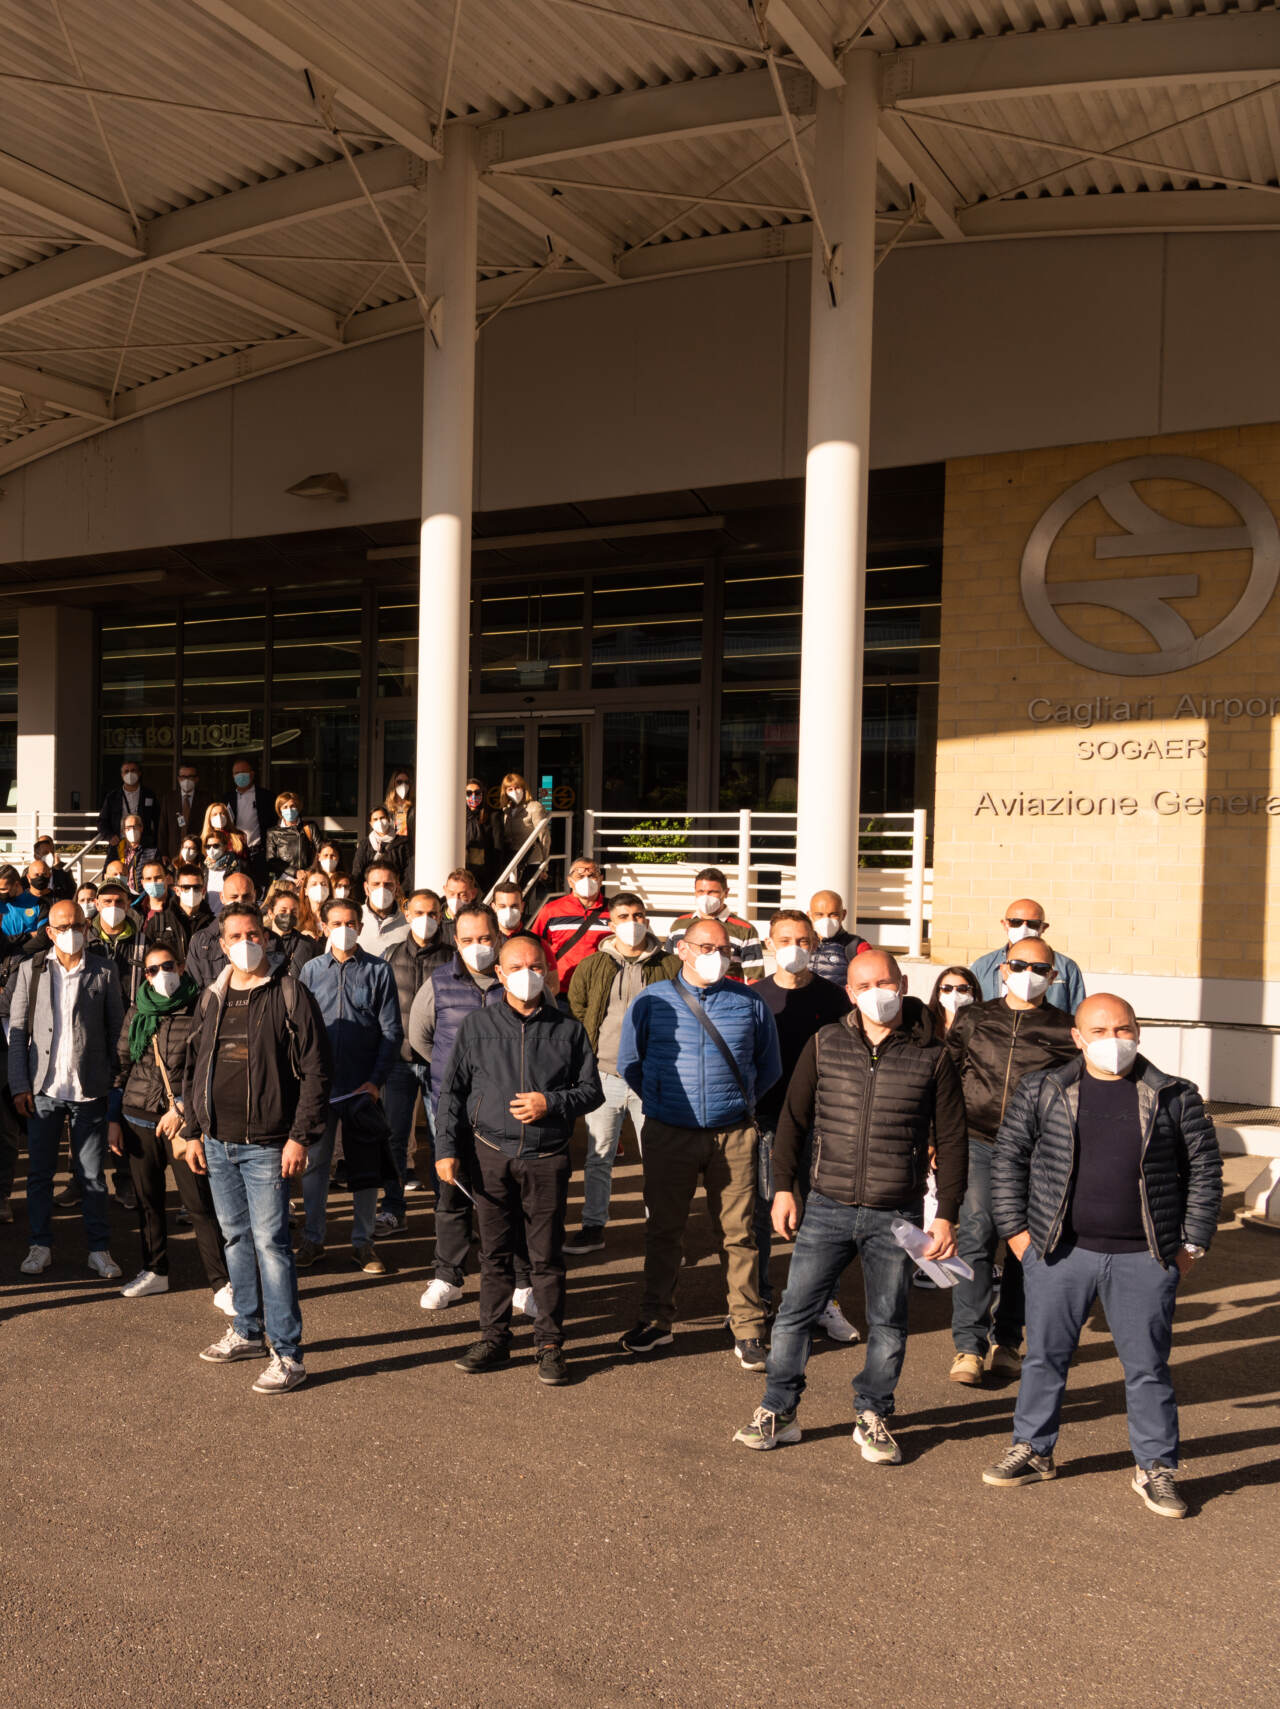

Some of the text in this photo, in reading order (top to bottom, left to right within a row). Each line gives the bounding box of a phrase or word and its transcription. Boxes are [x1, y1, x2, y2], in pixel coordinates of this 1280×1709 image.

[1027, 693, 1280, 729] Cagliari Airpor
[1077, 738, 1208, 761] SOGAER
[973, 789, 1280, 817] Aviazione Genera
